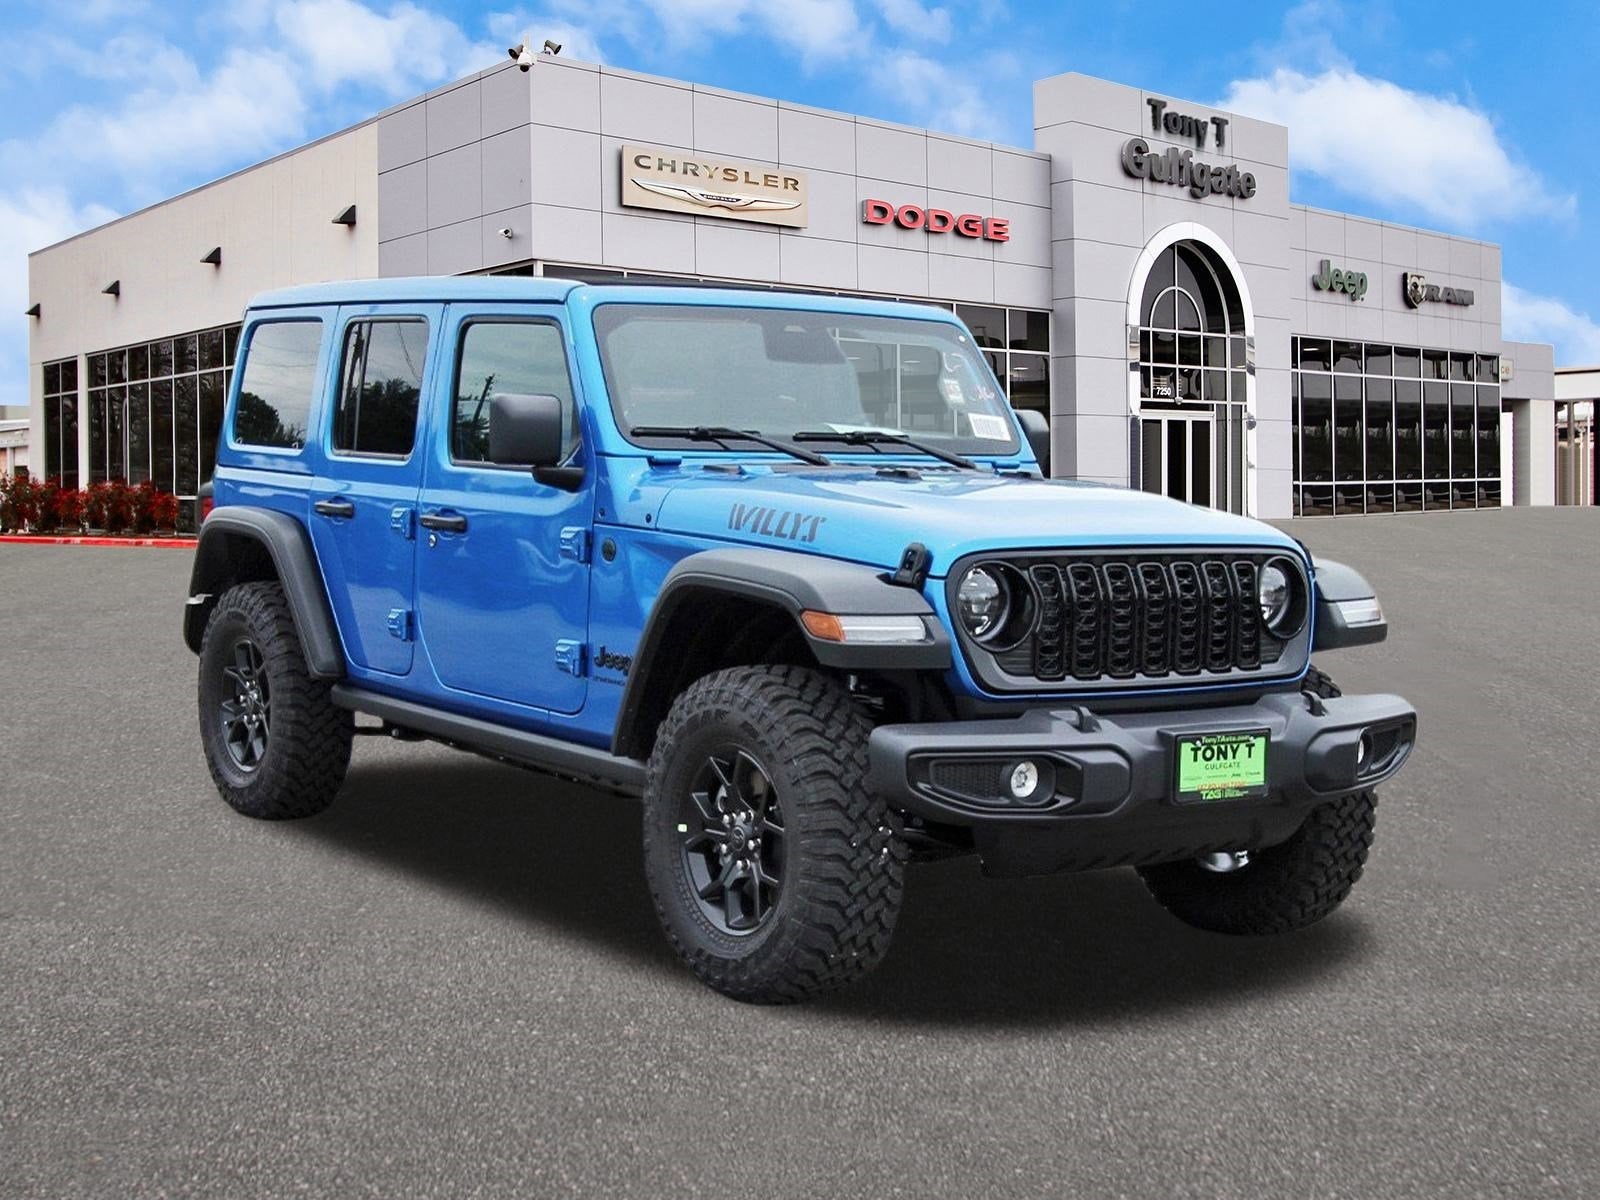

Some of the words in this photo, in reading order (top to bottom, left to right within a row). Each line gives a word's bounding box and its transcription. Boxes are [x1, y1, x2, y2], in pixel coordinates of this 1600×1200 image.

[1146, 98, 1208, 147] Tony
[1210, 116, 1229, 147] T
[634, 154, 800, 192] CHRYSLER
[1121, 138, 1256, 199] Gulfgate
[863, 199, 1011, 242] DODGE
[1312, 260, 1367, 301] Jeep
[1424, 284, 1475, 306] RAM
[728, 503, 827, 543] WILLYS
[594, 645, 632, 677] Jeep
[1190, 744, 1240, 762] TONY
[1245, 743, 1255, 758] T
[1204, 761, 1240, 770] GULFGATE
